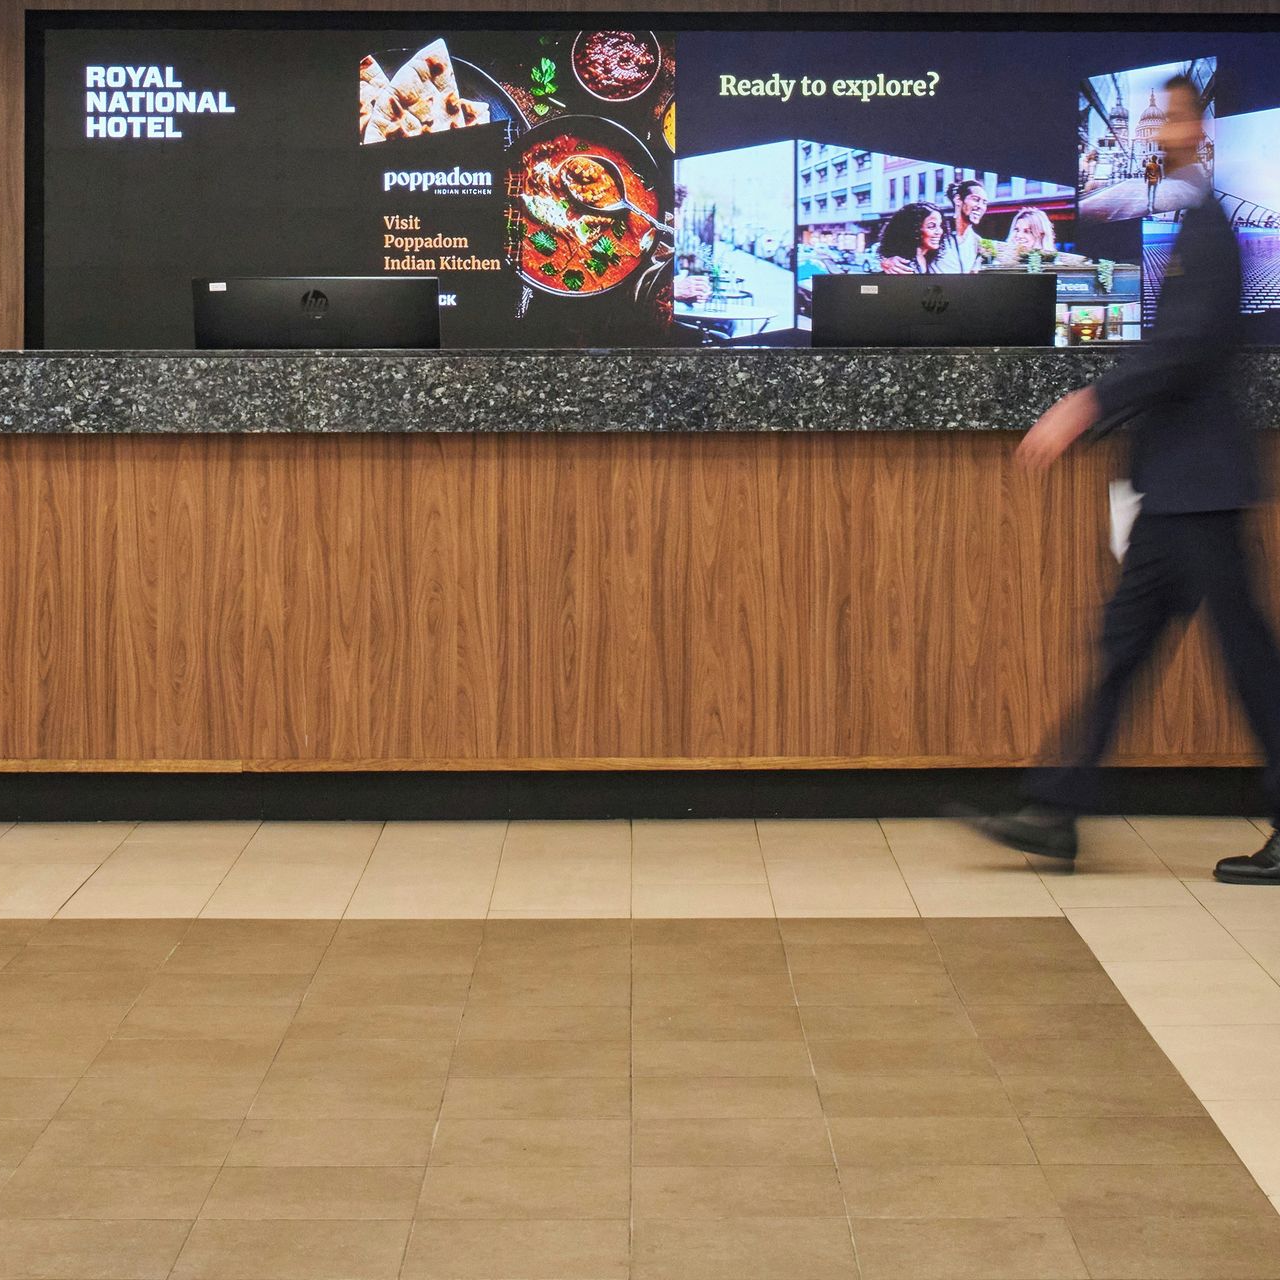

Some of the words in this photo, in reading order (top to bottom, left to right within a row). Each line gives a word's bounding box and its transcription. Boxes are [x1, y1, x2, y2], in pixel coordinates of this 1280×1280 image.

[86, 66, 183, 88] ROYAL
[719, 73, 796, 102] Ready
[800, 76, 827, 97] to
[832, 71, 941, 102] explore?
[86, 91, 236, 113] NATIONAL
[86, 116, 183, 138] HOTEL
[383, 166, 493, 192] poppadom
[384, 214, 421, 230] Visit
[384, 233, 469, 252] Poppadom
[384, 255, 436, 270] Indian
[439, 255, 501, 270] Kitchen
